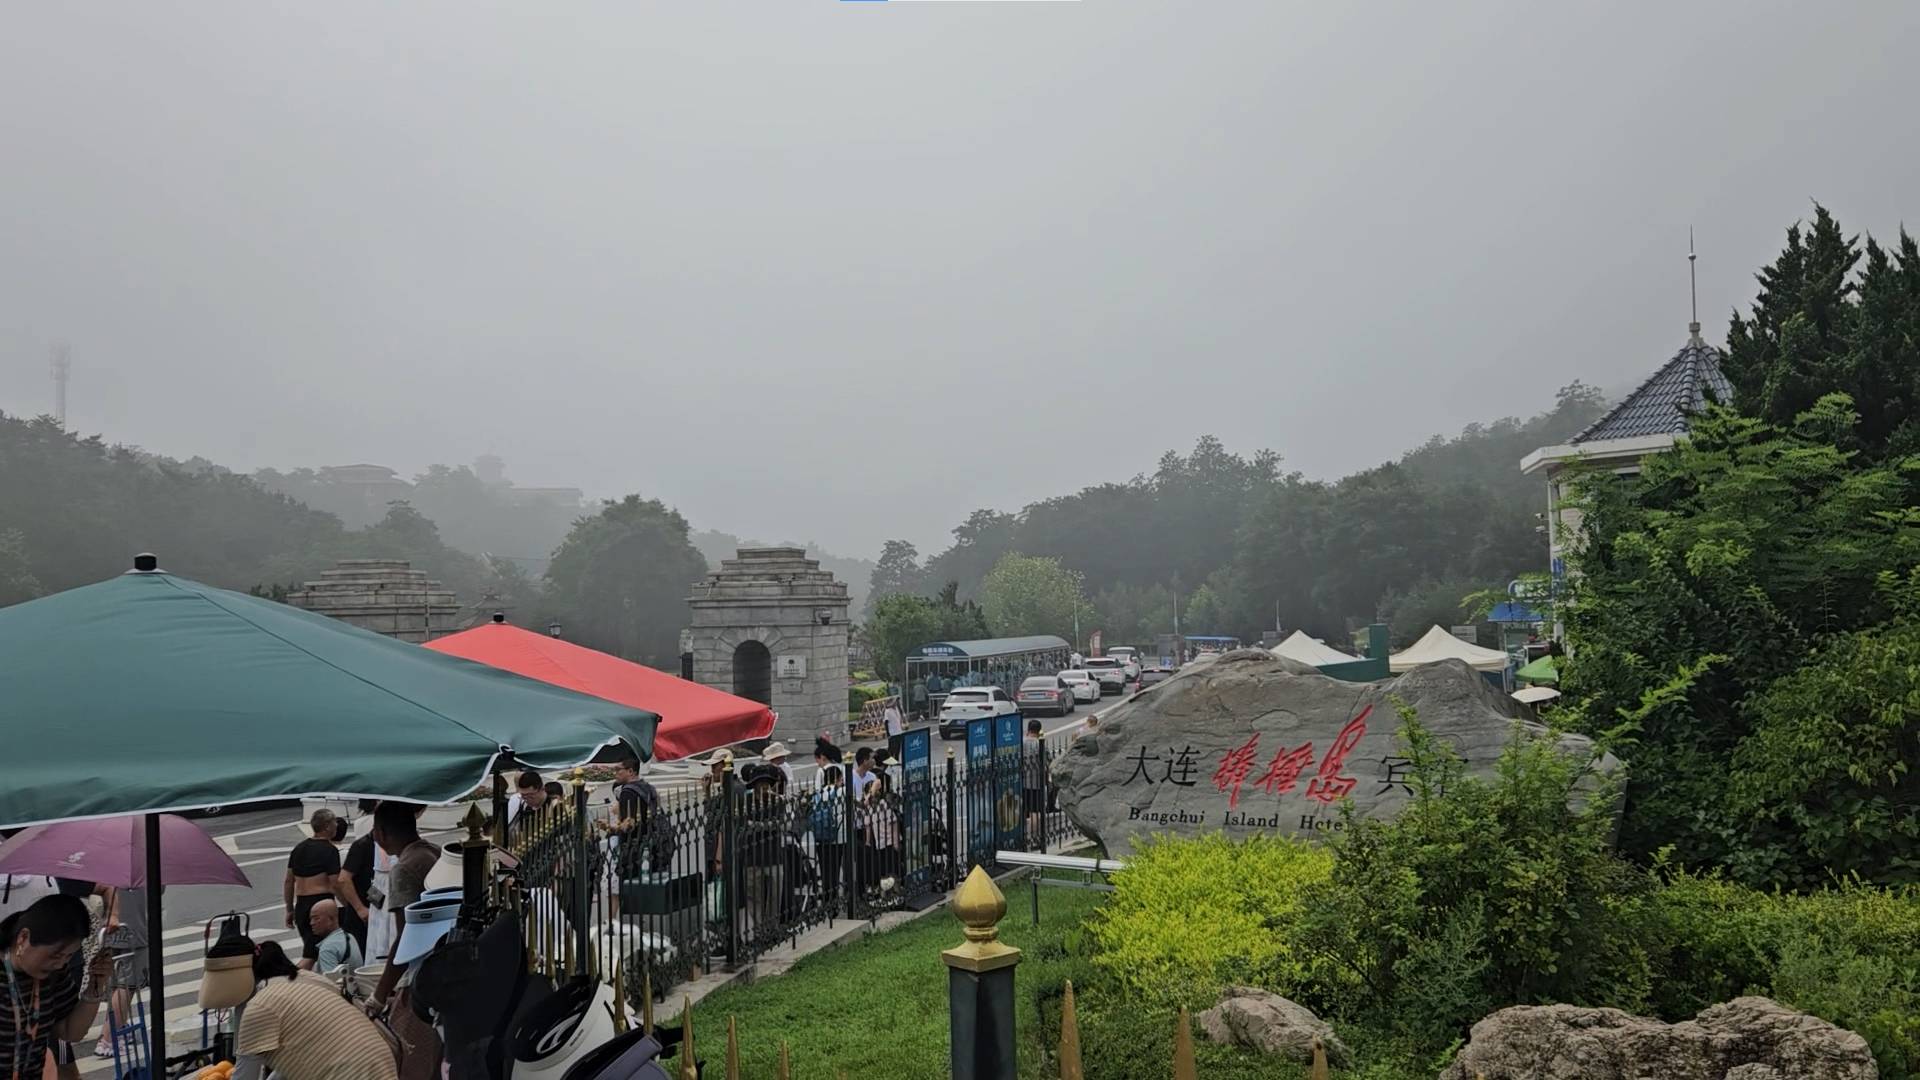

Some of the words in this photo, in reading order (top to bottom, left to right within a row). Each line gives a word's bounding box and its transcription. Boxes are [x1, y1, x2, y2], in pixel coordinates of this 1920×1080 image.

[1128, 807, 1205, 826] Bangchui
[1223, 811, 1279, 828] Island
[1299, 815, 1349, 832] Hote
